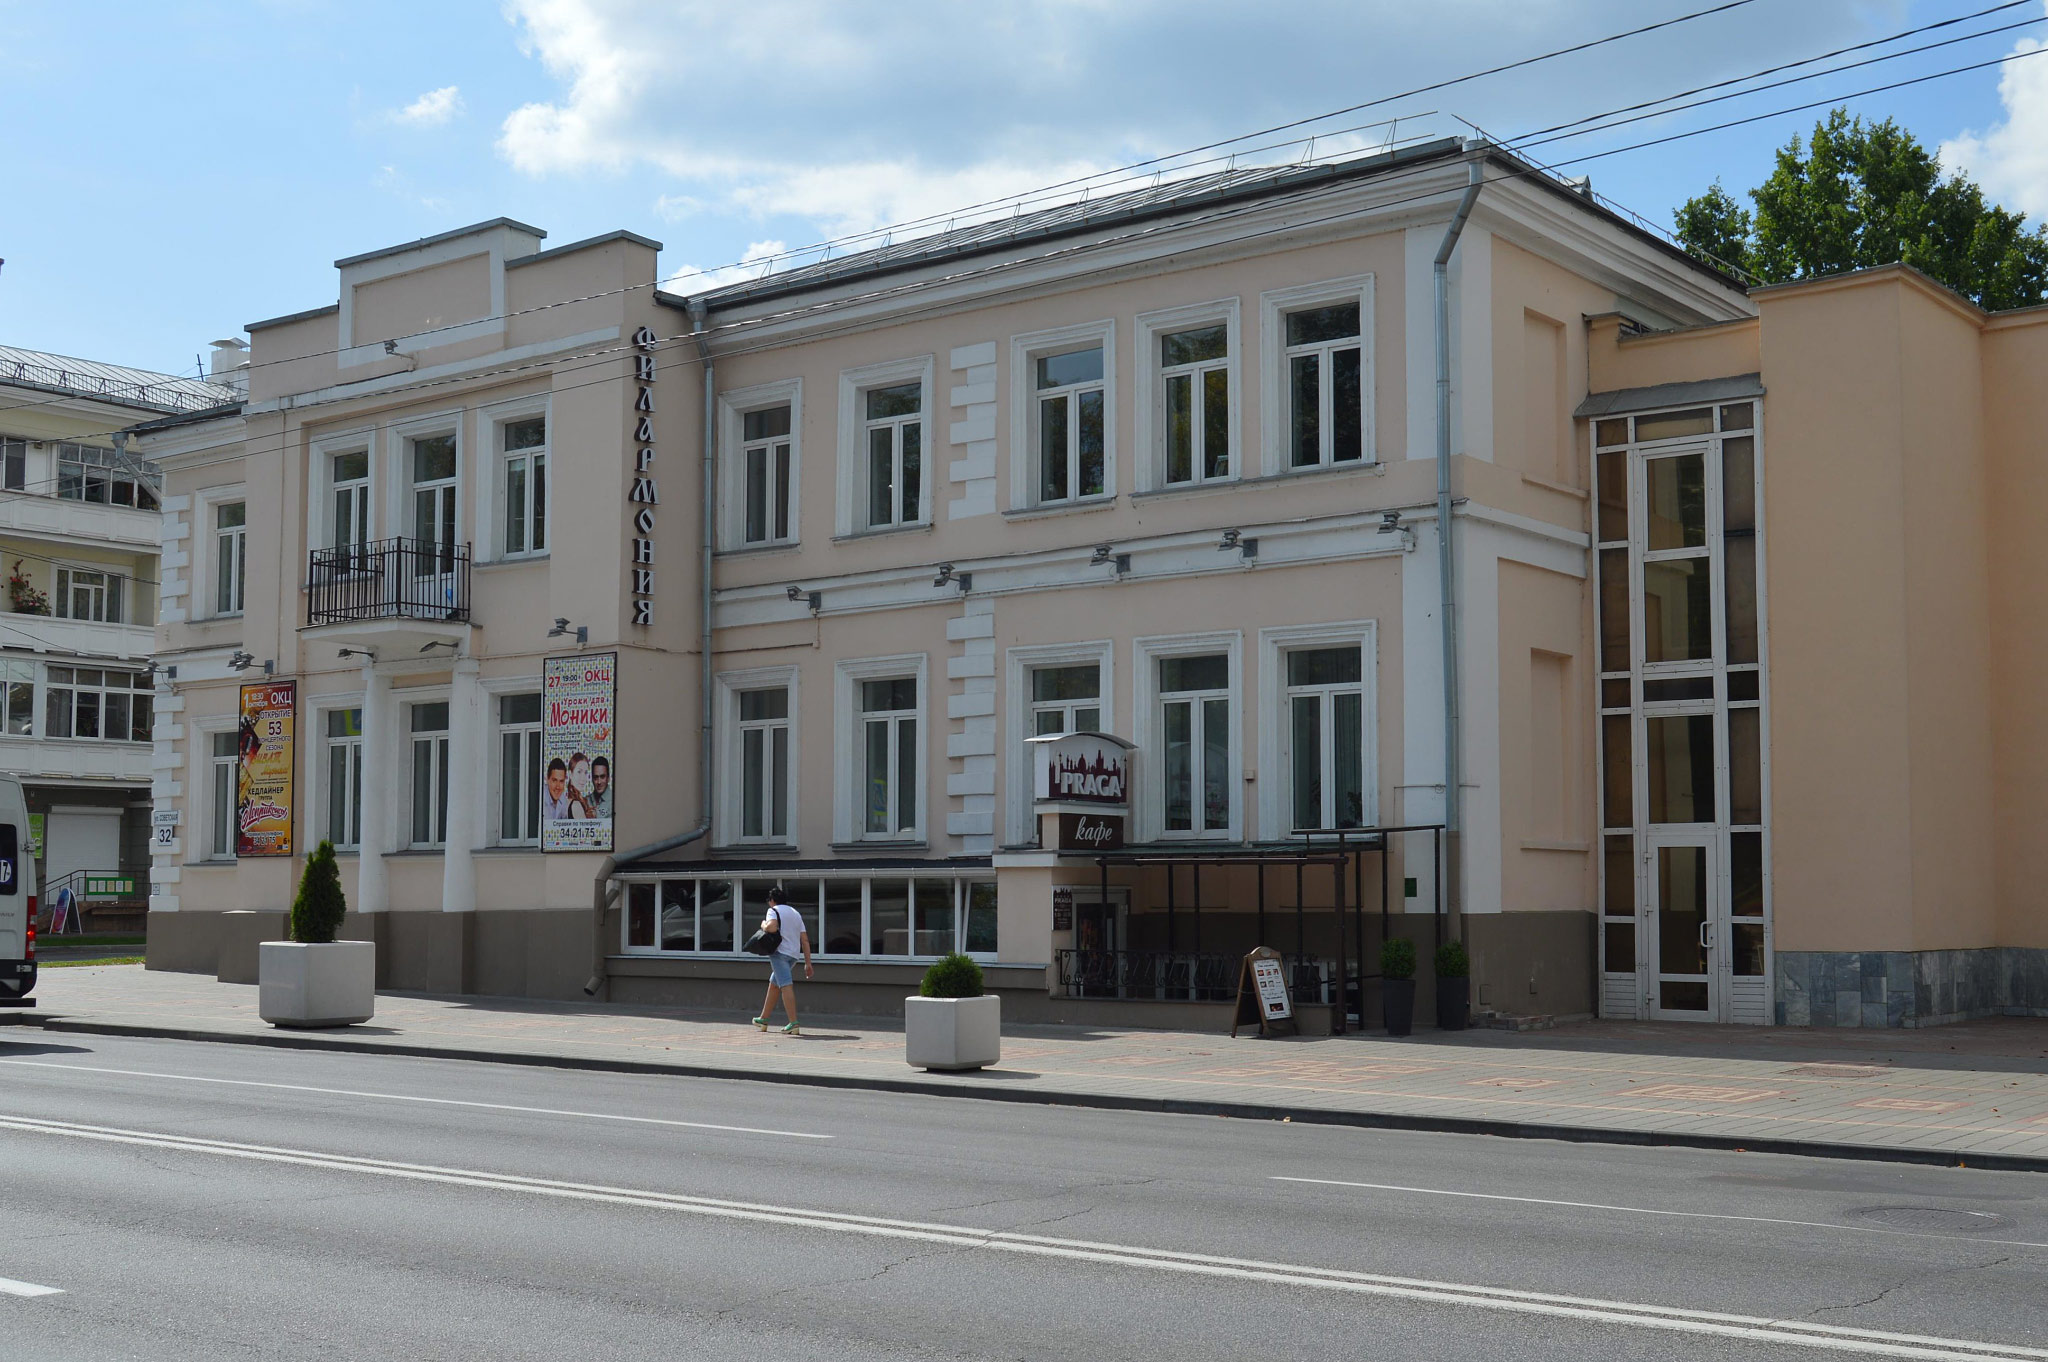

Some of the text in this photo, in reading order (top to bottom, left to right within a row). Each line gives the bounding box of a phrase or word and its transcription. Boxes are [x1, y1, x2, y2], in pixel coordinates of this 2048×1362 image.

[630, 326, 660, 626] ФИЛАРМОНИЯ
[548, 676, 560, 687] 27
[584, 669, 610, 682] ОКЦ
[244, 693, 249, 708] 1
[270, 690, 292, 704] ОКЦ
[249, 699, 268, 708] октября
[563, 696, 605, 707] Уроки для
[260, 709, 291, 719] ОТКРЫТИЕ
[550, 702, 608, 727] Моники
[268, 720, 282, 735] 53
[258, 735, 291, 743] КОНЦЕРТНОГО
[247, 786, 284, 795] ХЕДЛАЙНЕР
[1060, 772, 1122, 797] PRAGA
[159, 829, 171, 843] 32
[560, 827, 595, 838] 34 21 75
[1075, 816, 1113, 847] кафе
[253, 836, 276, 845] 34 21 75
